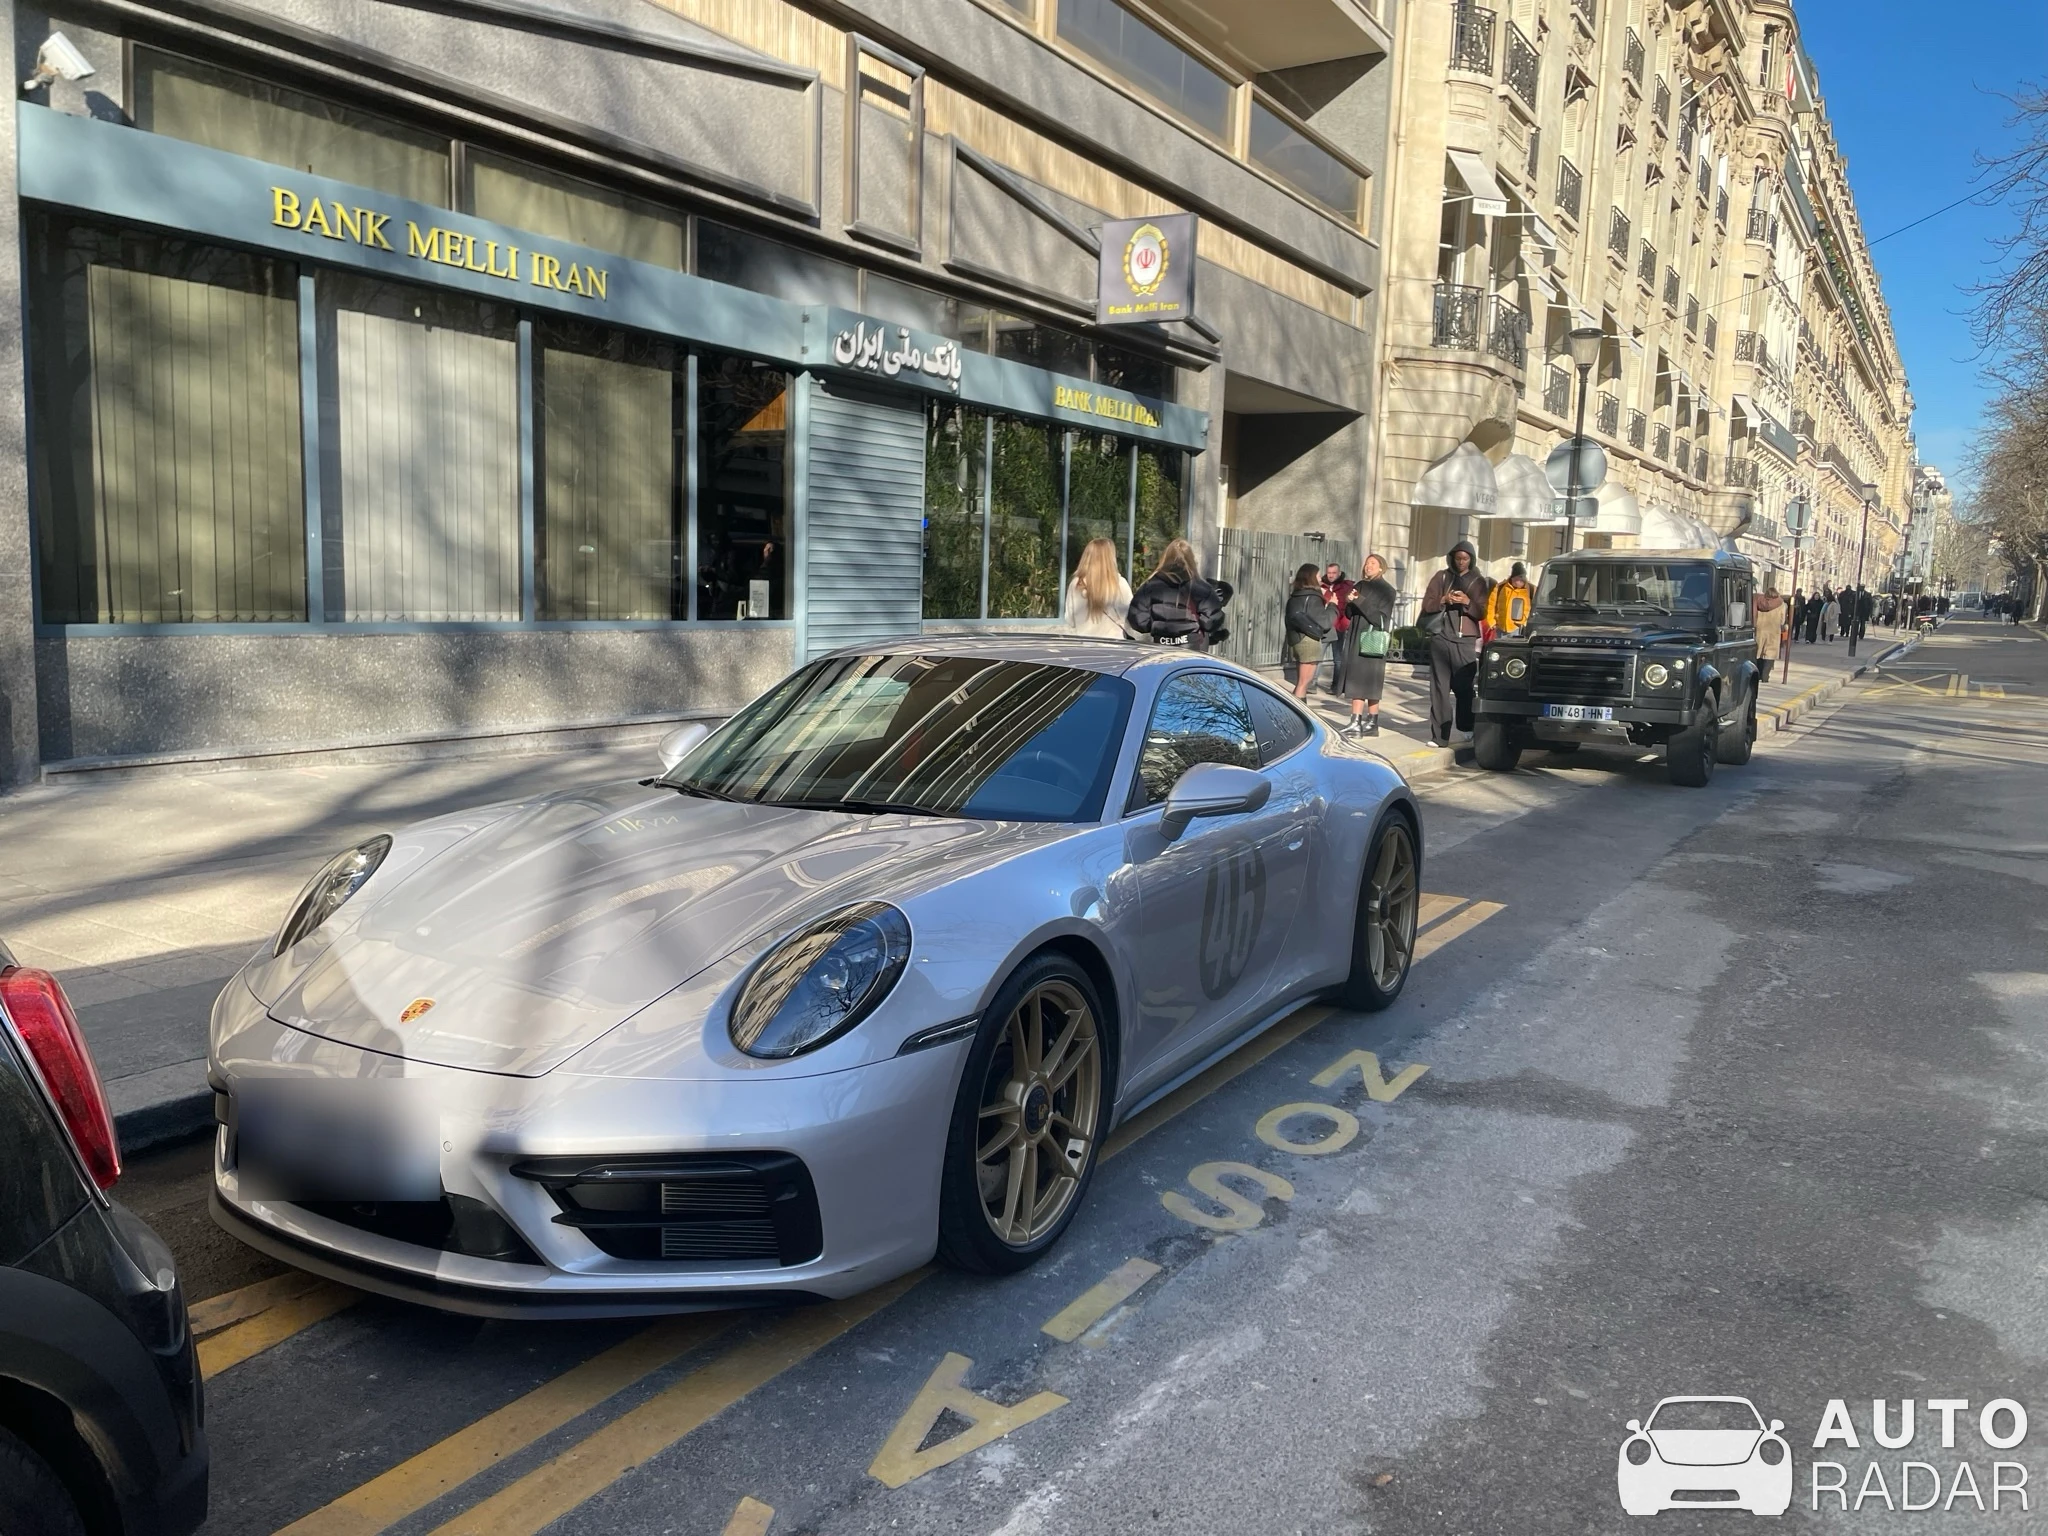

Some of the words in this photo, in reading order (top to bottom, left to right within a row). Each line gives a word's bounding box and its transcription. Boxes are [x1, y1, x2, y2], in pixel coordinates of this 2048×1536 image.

[270, 186, 394, 251] BANK
[406, 221, 519, 281] MELLI
[529, 251, 608, 301] IRAN
[1108, 304, 1133, 314] Bank
[1135, 302, 1158, 312] Melli
[1160, 302, 1180, 311] Iran
[833, 321, 885, 370] ایران
[922, 341, 962, 391] بانک
[1055, 385, 1093, 413] BANK
[1095, 395, 1133, 423] MELLI
[1160, 634, 1188, 645] CELINE
